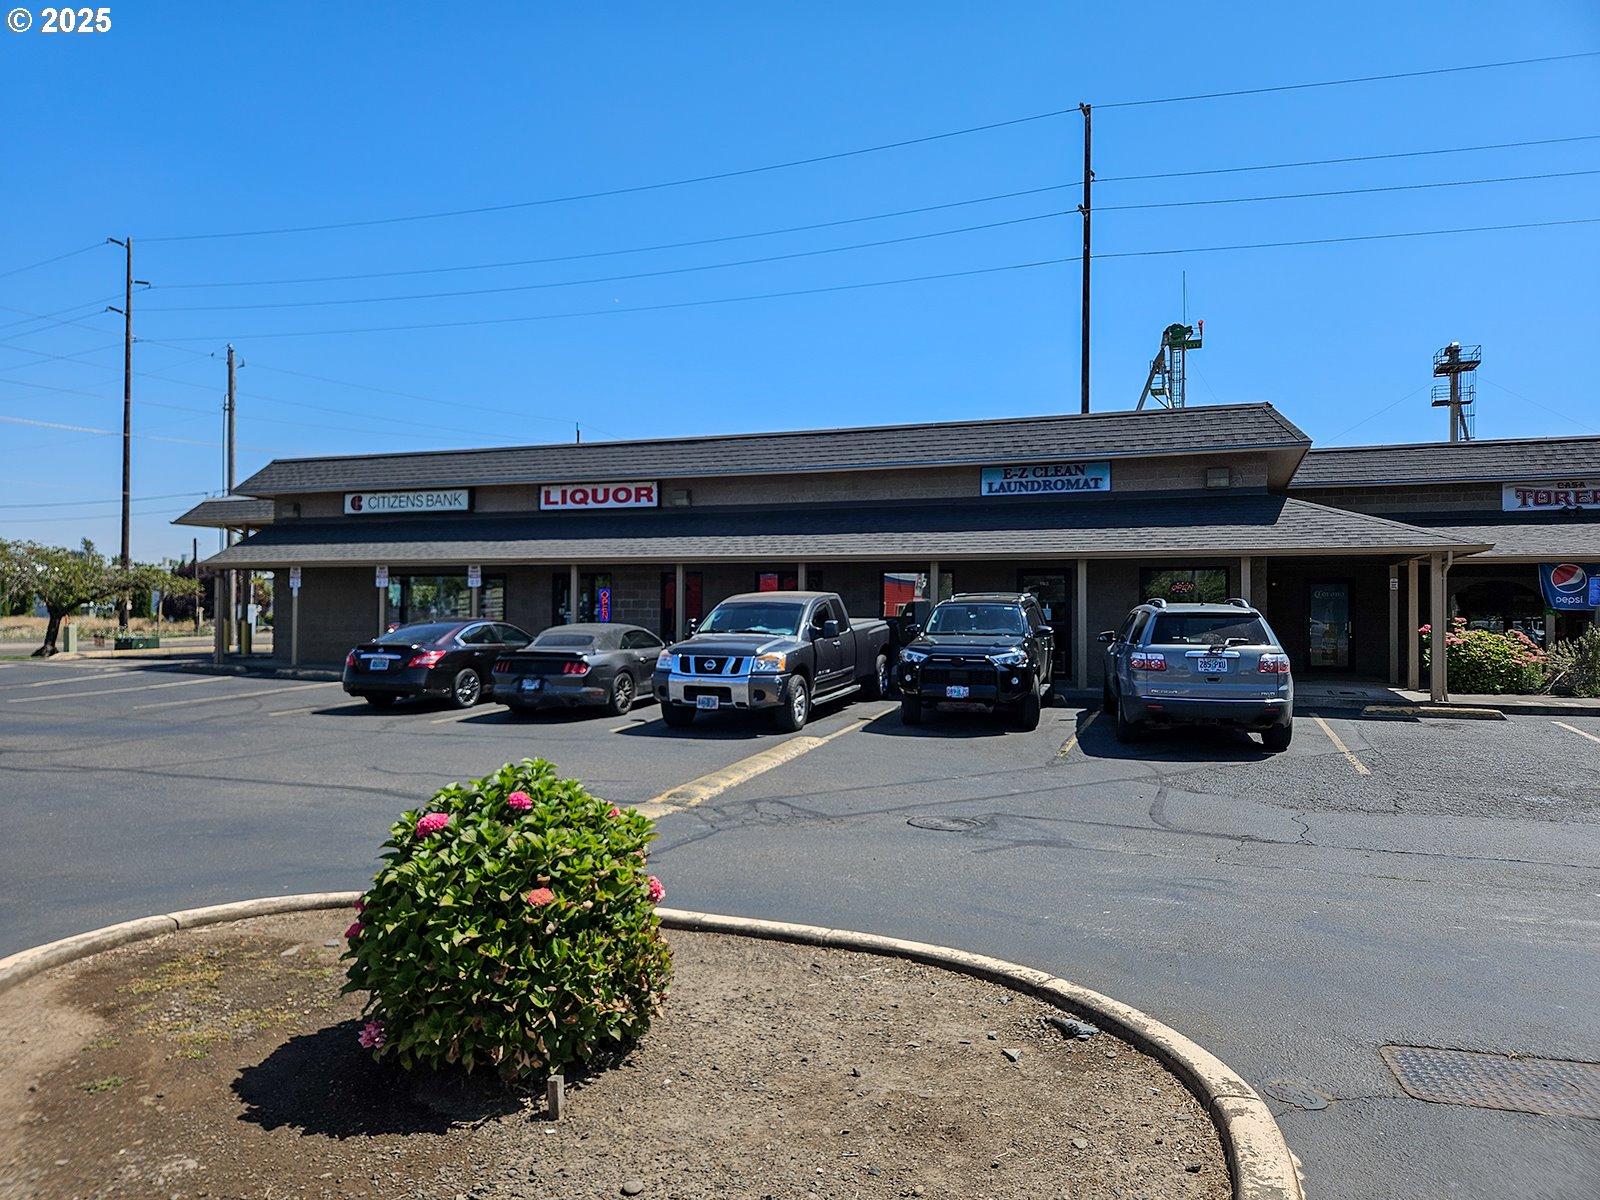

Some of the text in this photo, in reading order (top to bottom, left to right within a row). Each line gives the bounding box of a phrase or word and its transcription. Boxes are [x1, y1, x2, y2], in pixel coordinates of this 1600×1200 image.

[1003, 464, 1085, 479] E-Z CLEAN
[987, 477, 1103, 494] LAUNDROMAT
[1557, 481, 1586, 489] CASA
[368, 494, 424, 510] CITIZENS
[426, 492, 462, 508] BANK
[544, 487, 654, 506] LIQUOR
[601, 591, 609, 619] OPEN
[1555, 596, 1584, 605] pepsi
